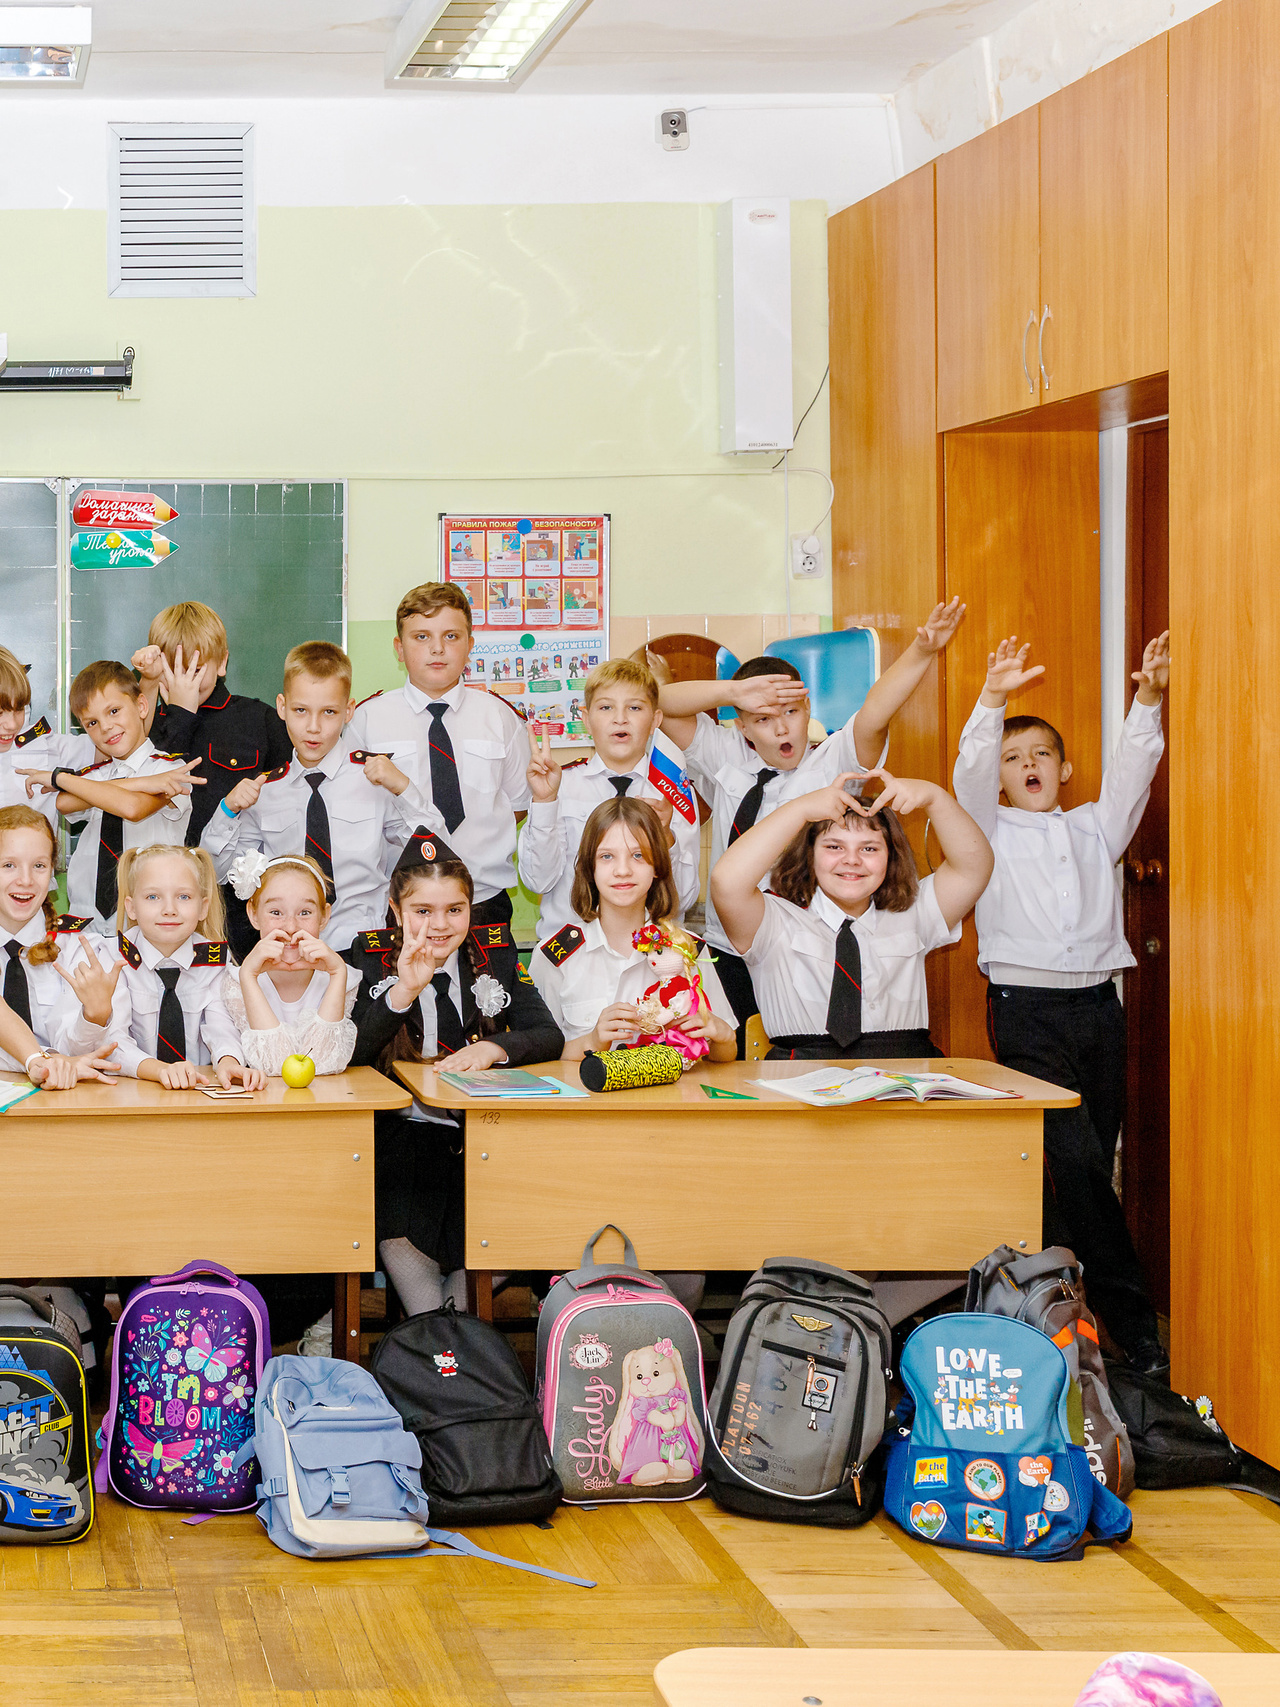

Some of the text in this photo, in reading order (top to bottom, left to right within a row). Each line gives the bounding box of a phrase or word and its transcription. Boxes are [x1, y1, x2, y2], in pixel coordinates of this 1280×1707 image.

[78, 493, 156, 512] Домашнее
[451, 520, 597, 529] ПРАВИЛА ПОЖАР БЕЗОПАСНОСТИ
[83, 533, 133, 550] Теа
[657, 779, 691, 813] РОССИЯ
[480, 1111, 501, 1125] 132
[935, 1346, 1002, 1378] LOVE
[944, 1374, 988, 1400] THE
[138, 1394, 222, 1431] BLOOM
[941, 1402, 1024, 1432] EARTH
[44, 1421, 60, 1432] CLUB
[928, 1462, 945, 1471] the
[1026, 1466, 1050, 1476] Earth
[1029, 1461, 1044, 1469] the
[918, 1472, 945, 1483] Earth
